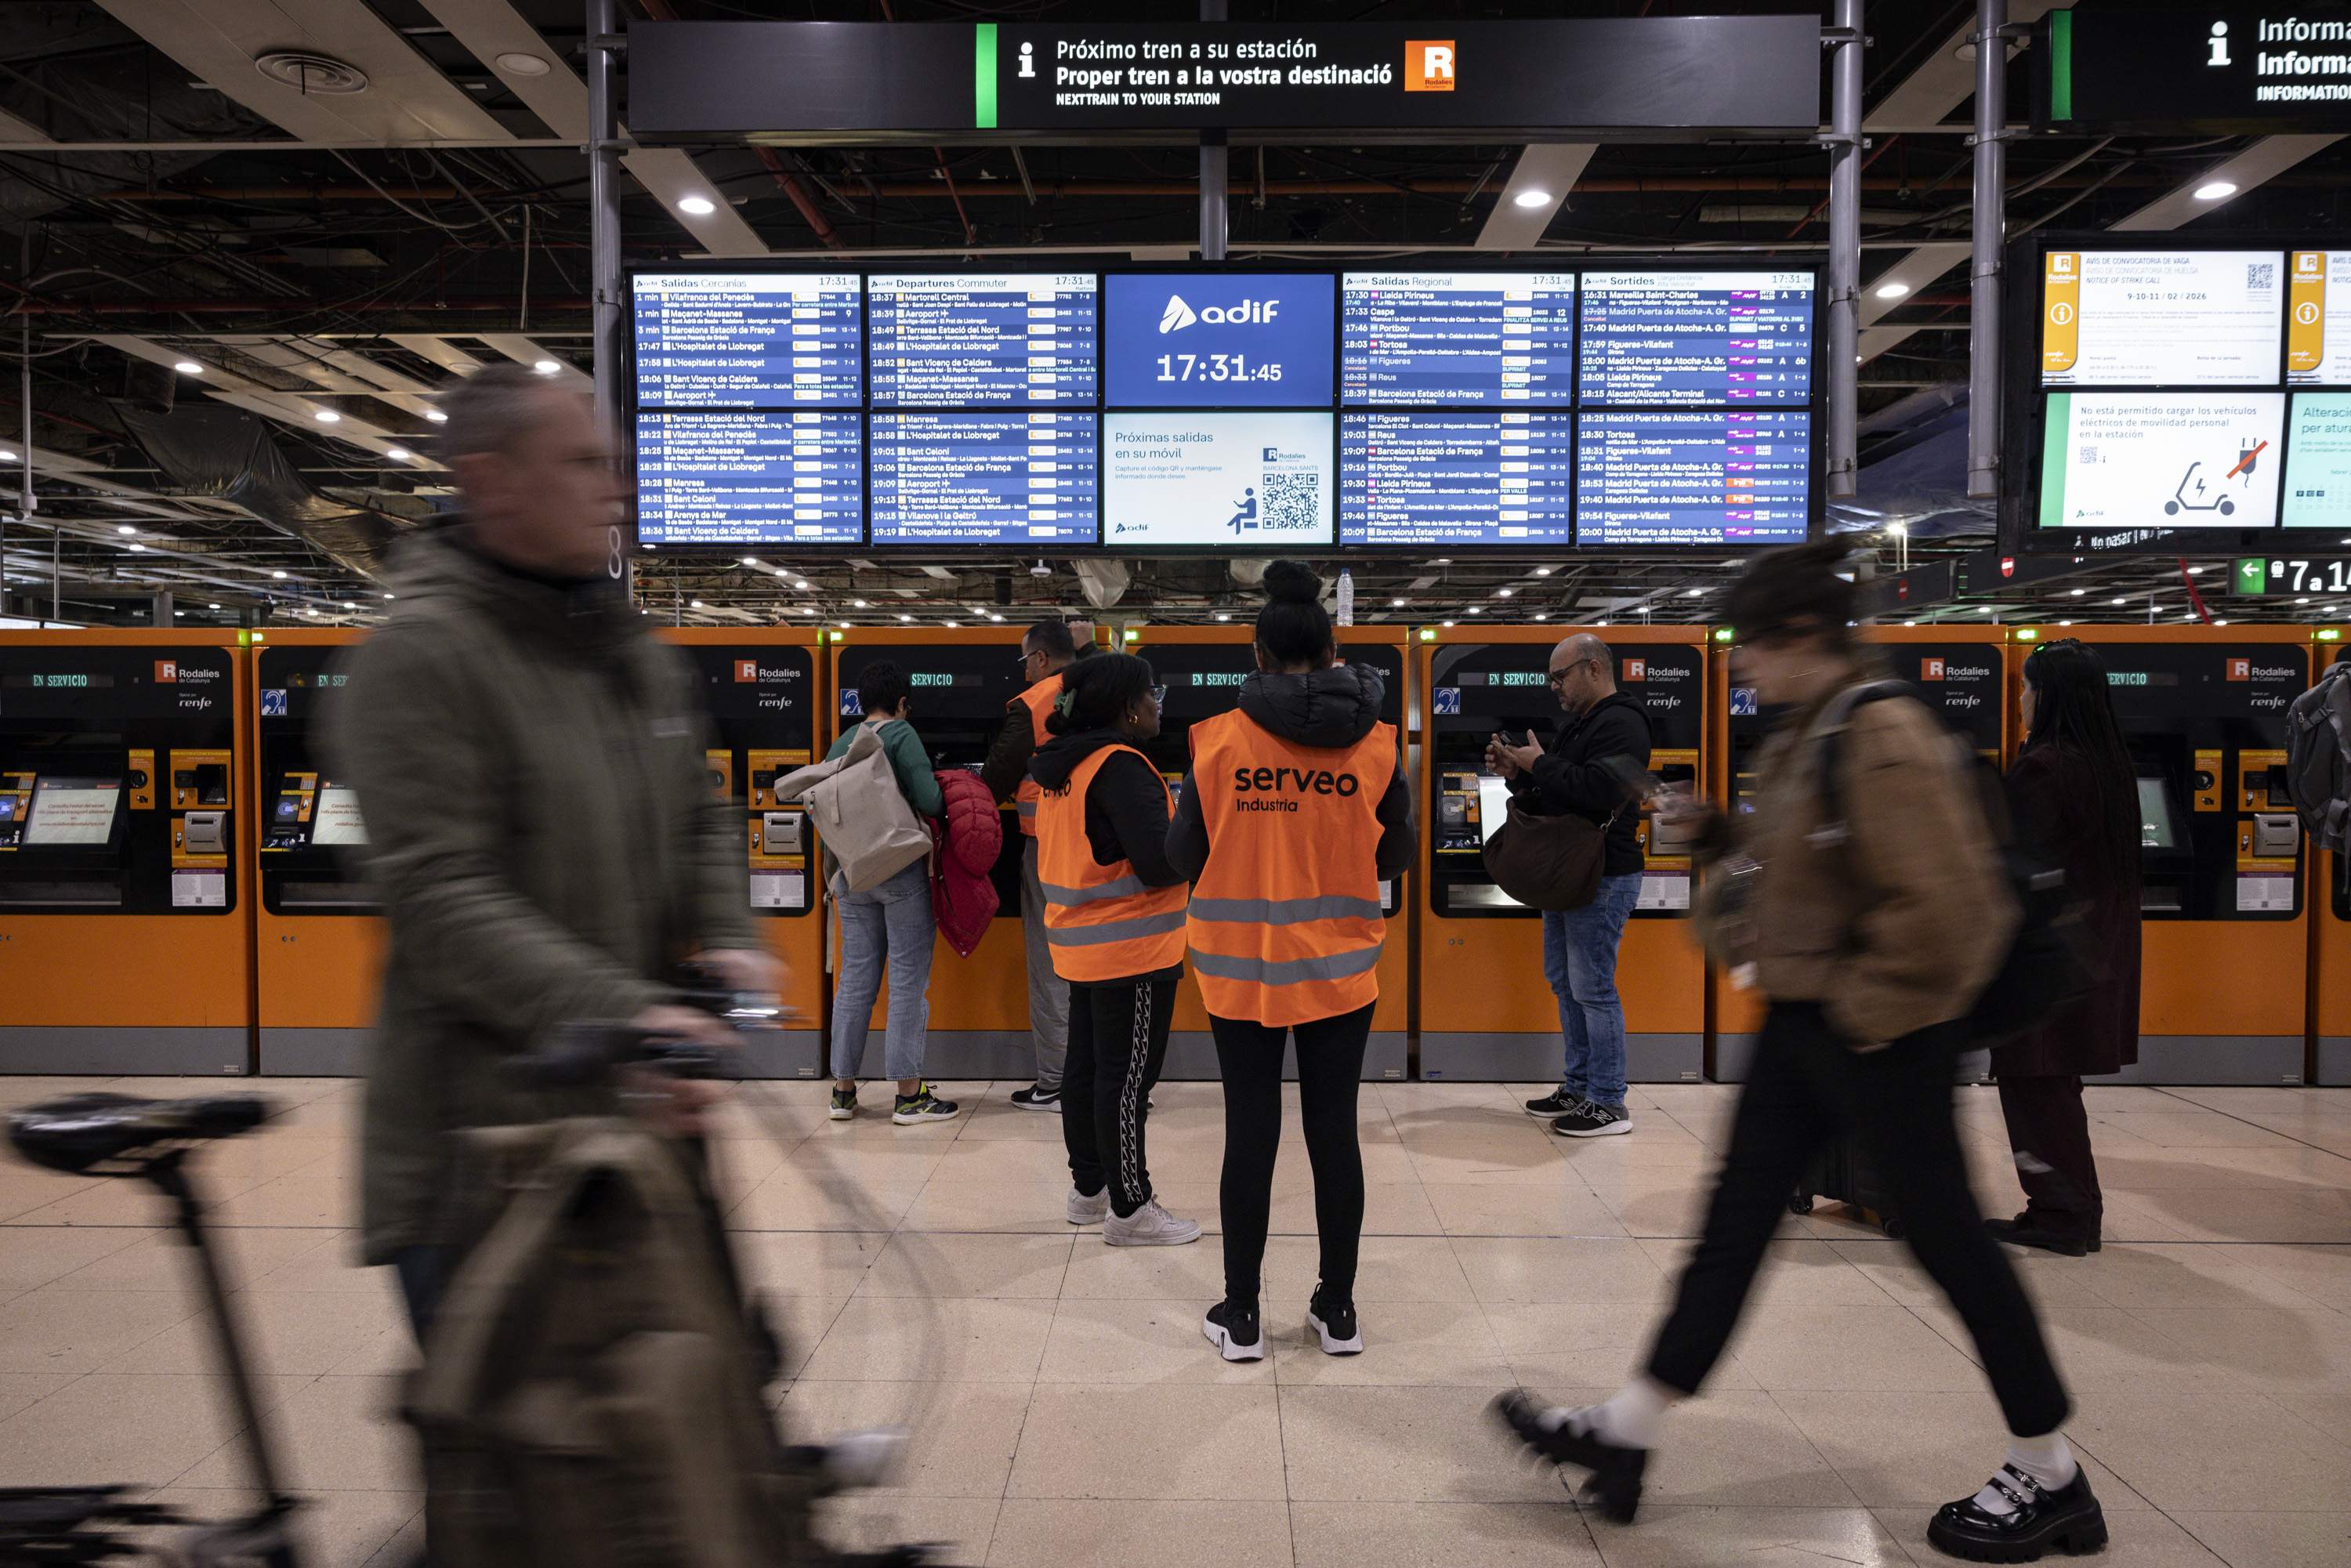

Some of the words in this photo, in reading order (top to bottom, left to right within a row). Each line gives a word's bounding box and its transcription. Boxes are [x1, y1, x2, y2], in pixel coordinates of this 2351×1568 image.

[1057, 39, 1136, 62] Próximo
[1143, 43, 1183, 60] tren
[1190, 45, 1201, 59] a
[1208, 45, 1229, 58] su
[1237, 39, 1317, 58] estación
[1425, 46, 1453, 78] R
[1056, 67, 1122, 89] Proper
[1128, 69, 1170, 85] tren
[1176, 71, 1188, 85] a
[1195, 67, 1214, 84] la
[1220, 68, 1280, 85] vostra
[1288, 63, 1392, 85] destinació
[1123, 93, 1137, 106] TO
[1140, 93, 1171, 106] YOUR
[1175, 93, 1220, 106] STATION
[661, 279, 698, 288] Salidas
[701, 279, 746, 288] Cercanías
[897, 280, 955, 289] Departures
[957, 279, 1007, 288] Commuter
[1371, 277, 1410, 286] Salidas
[1412, 277, 1452, 287] Regional
[1610, 277, 1654, 286] Sortides
[1201, 299, 1280, 324] adif
[672, 342, 715, 351] L'Hospitalet
[729, 342, 764, 352] Llobregat
[1157, 354, 1282, 382] 17:31:45
[2117, 407, 2164, 417] permitido
[2166, 407, 2194, 417] cargar
[2214, 406, 2257, 415] vehículos
[2190, 419, 2229, 429] personal
[2302, 425, 2320, 435] per
[1115, 432, 1169, 445] Próximas
[1172, 432, 1213, 443] salidas
[2094, 430, 2103, 439] la
[2106, 429, 2143, 439] estación
[1115, 450, 1130, 458] en
[1133, 450, 1146, 458] su
[1149, 448, 1182, 458] móvil
[2289, 561, 2309, 591] 7
[2309, 577, 2322, 592] a
[2327, 561, 2351, 592] 1
[163, 664, 176, 678] R
[179, 669, 219, 678] Rodalies
[743, 664, 756, 677] R
[759, 668, 801, 677] Rodalies
[1631, 662, 1644, 676] R
[1647, 668, 1690, 676] Rodalies
[1930, 661, 1943, 675] R
[1947, 667, 1990, 675] Rodalies
[2235, 661, 2248, 675] R
[2251, 668, 2295, 676] Rodalies
[33, 675, 44, 686] EN
[48, 675, 87, 686] SERVICIO
[318, 675, 328, 686] EN
[911, 674, 952, 686] SERVICIO
[1193, 674, 1202, 686] EN
[1489, 674, 1499, 685] EN
[1504, 673, 1545, 685] SERVICIO
[179, 697, 212, 711] renfe
[759, 696, 792, 710] renfe
[1647, 696, 1681, 709] renfe
[1946, 695, 1980, 708] renfe
[2251, 696, 2285, 709] renfe
[1234, 767, 1358, 797] serveo
[1237, 798, 1298, 812] Industria
